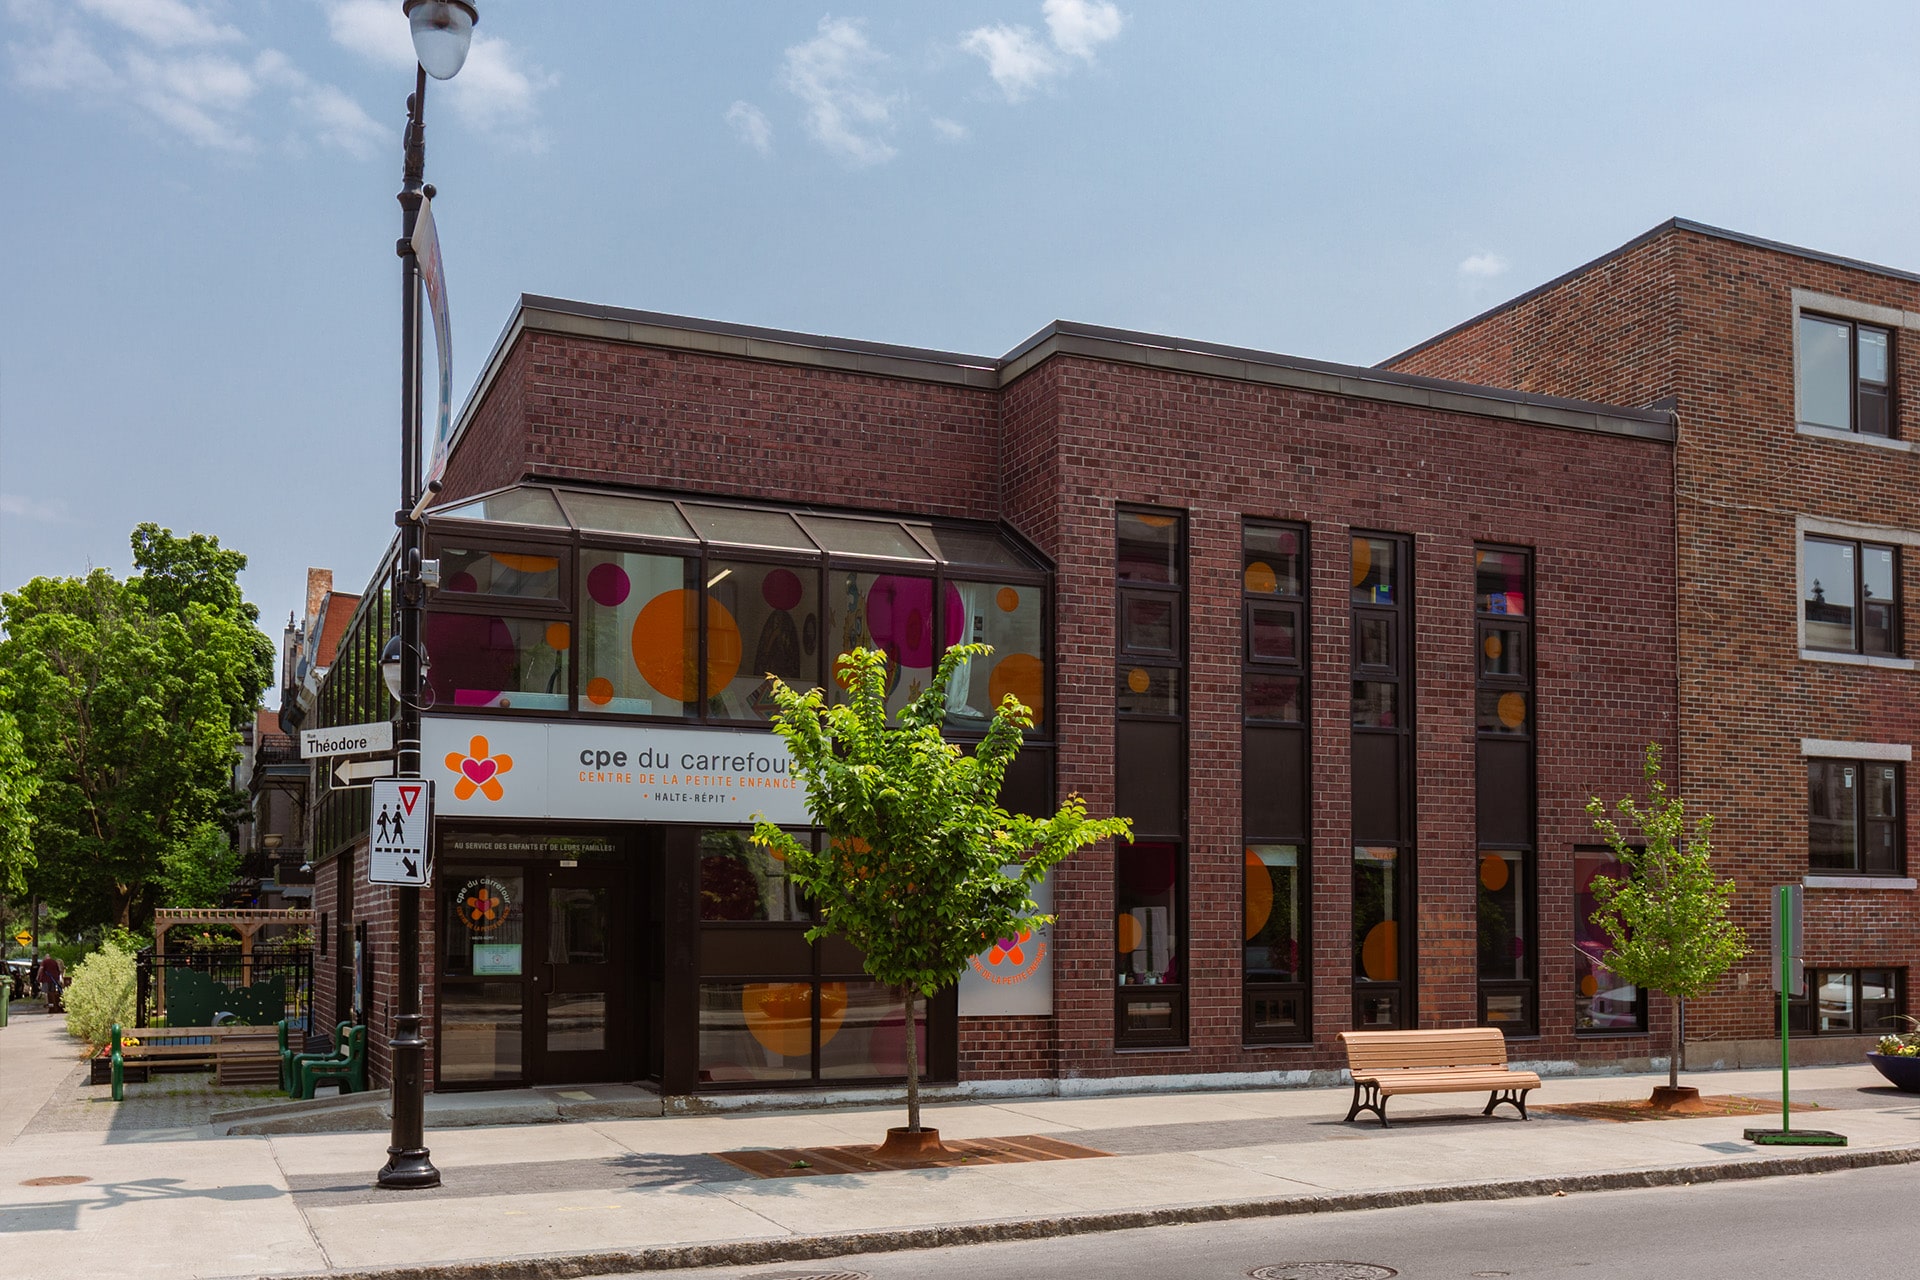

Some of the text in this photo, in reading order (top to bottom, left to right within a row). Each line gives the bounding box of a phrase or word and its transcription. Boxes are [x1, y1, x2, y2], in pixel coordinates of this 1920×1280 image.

[307, 737, 367, 753] Théodore
[579, 747, 797, 774] cpe du carrefour
[579, 771, 797, 789] CENTRE DE LA PETITE ENFANCE
[654, 792, 726, 803] HALTE-RÉPIT
[465, 842, 493, 850] SERVICE
[509, 843, 538, 851] ENFANTS
[456, 878, 511, 904] cpe du carrefour
[981, 968, 992, 979] DE
[991, 974, 1001, 985] LA
[1002, 971, 1028, 985] PETITE
[1026, 942, 1047, 976] ENFANCE
